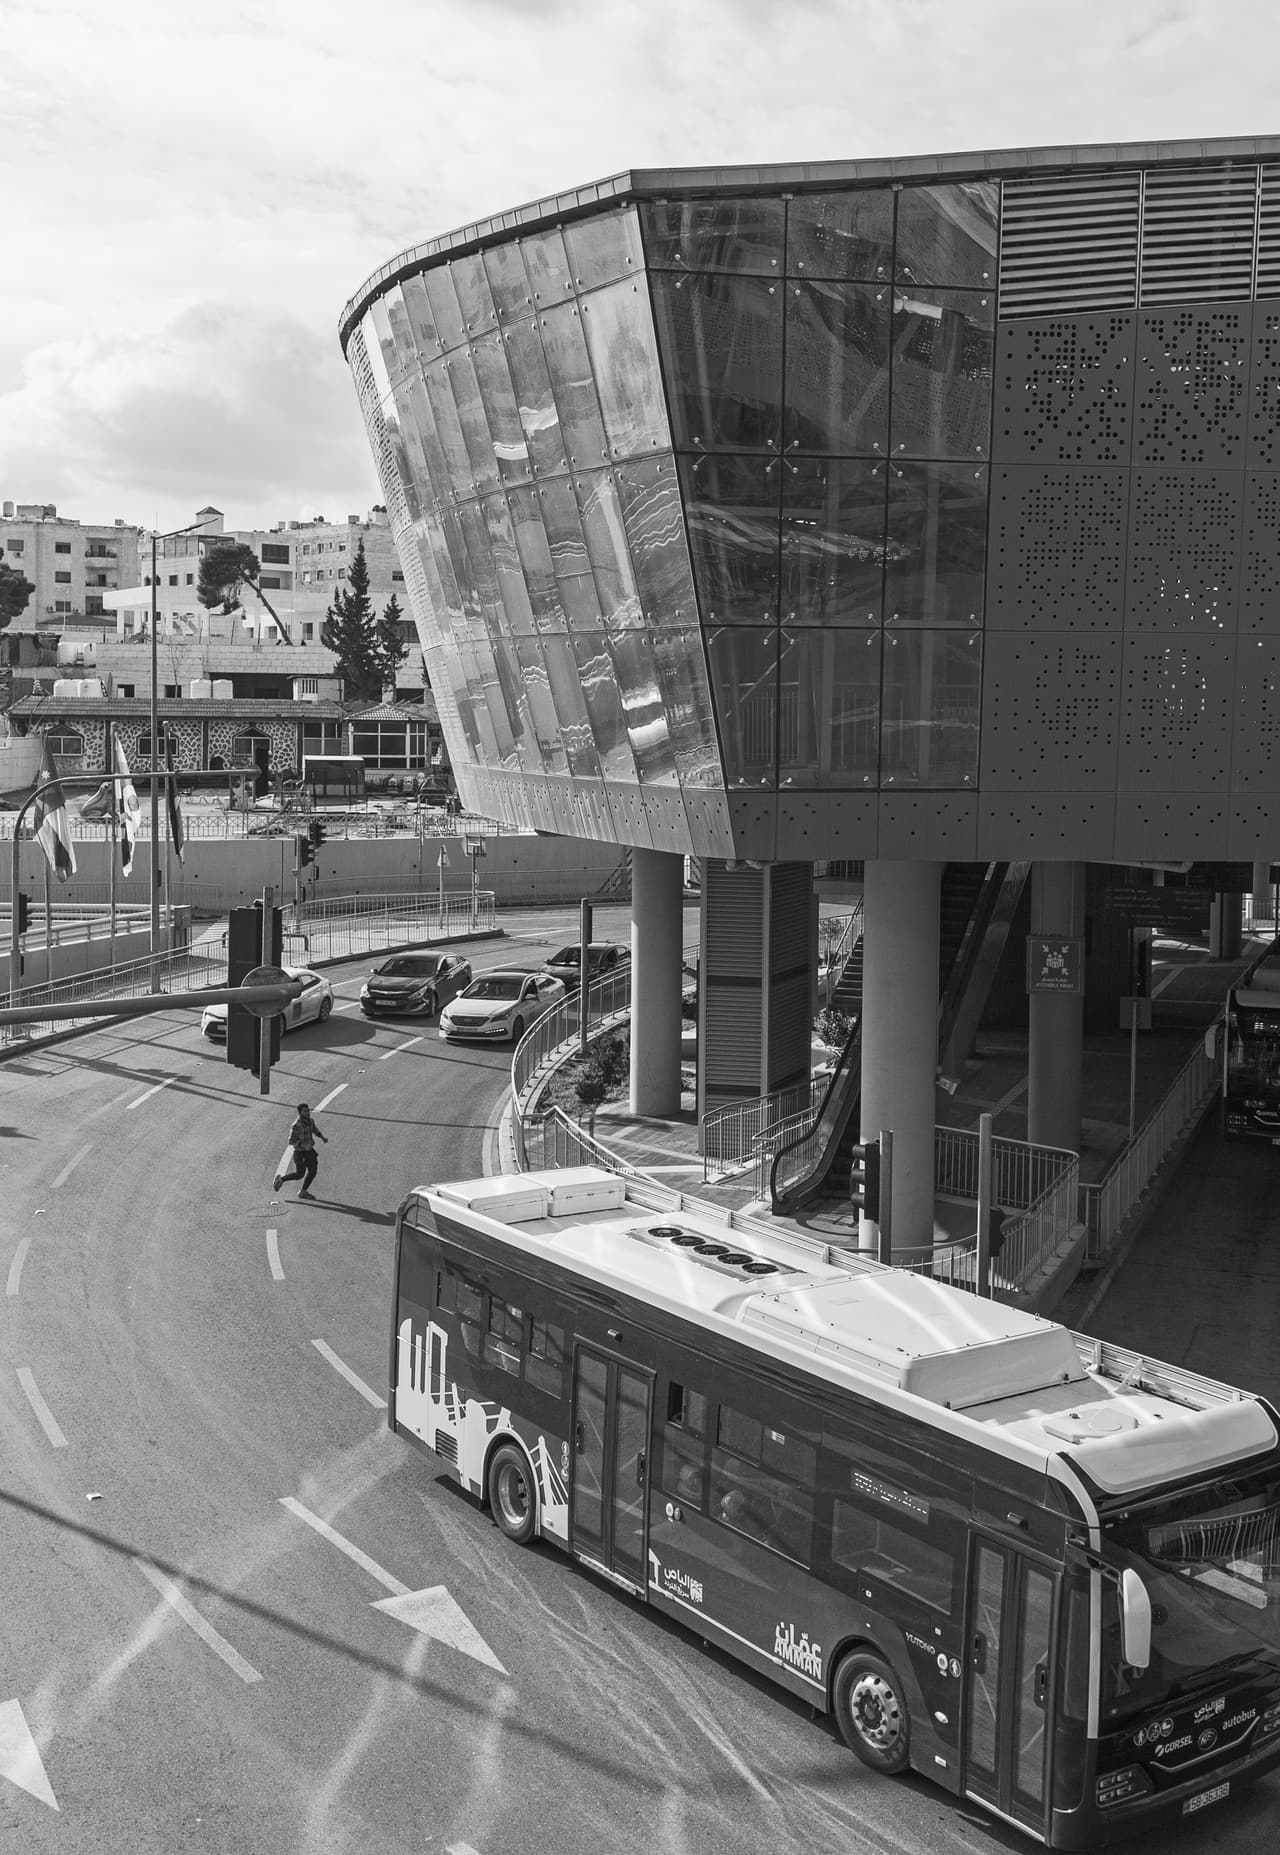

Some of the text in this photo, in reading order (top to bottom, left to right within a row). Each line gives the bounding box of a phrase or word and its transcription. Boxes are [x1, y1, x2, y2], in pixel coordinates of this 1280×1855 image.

[664, 1568, 690, 1589] الباص
[774, 1637, 822, 1680] AMMAN
[1222, 1708, 1257, 1730] autobus
